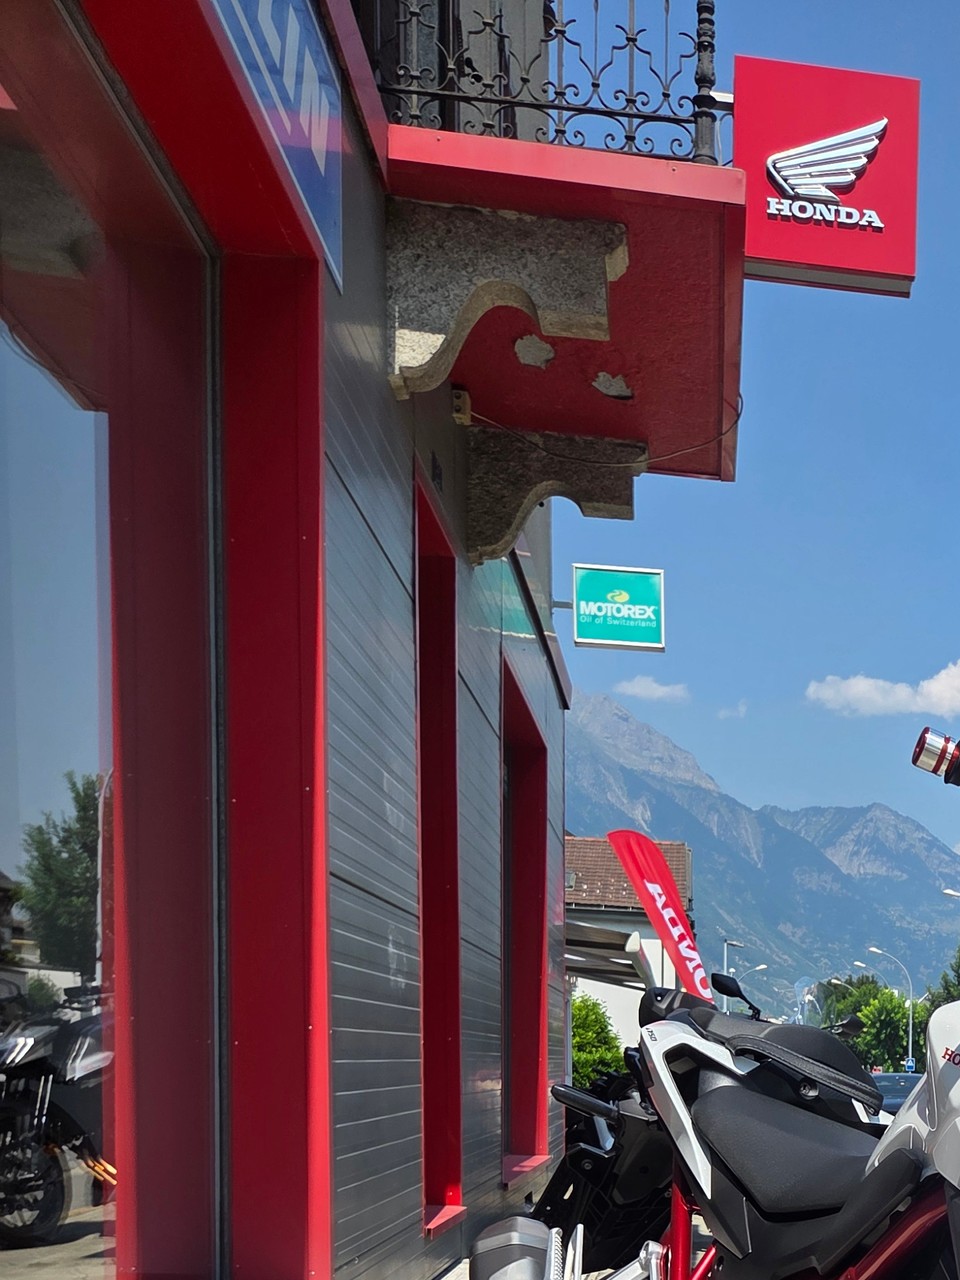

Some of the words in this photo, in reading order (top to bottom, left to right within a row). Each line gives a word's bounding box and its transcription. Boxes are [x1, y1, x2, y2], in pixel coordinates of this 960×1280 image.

[766, 197, 885, 229] HONDA
[579, 601, 656, 620] MOTOREX
[580, 615, 592, 623] Oil
[607, 618, 656, 628] Switzerland
